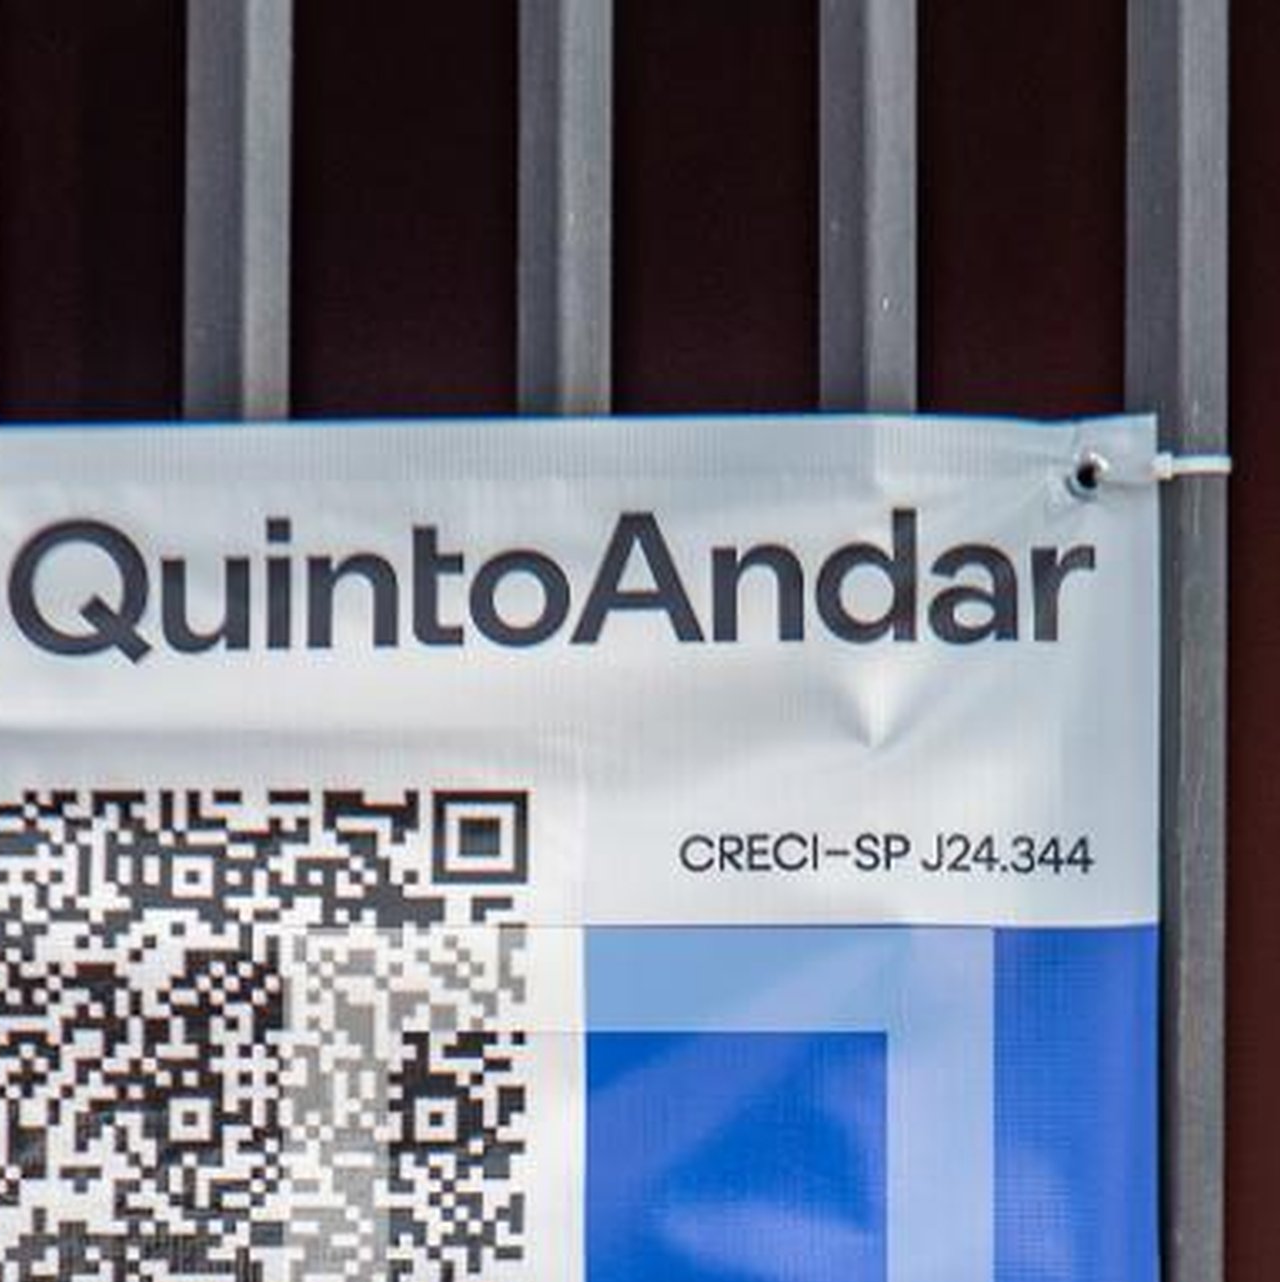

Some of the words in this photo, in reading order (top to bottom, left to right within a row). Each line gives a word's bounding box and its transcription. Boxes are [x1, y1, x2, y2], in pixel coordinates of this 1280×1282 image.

[7, 506, 1097, 665] QuintoAndar
[679, 832, 911, 873] CRECI-SP
[921, 834, 1095, 875] J24.344
